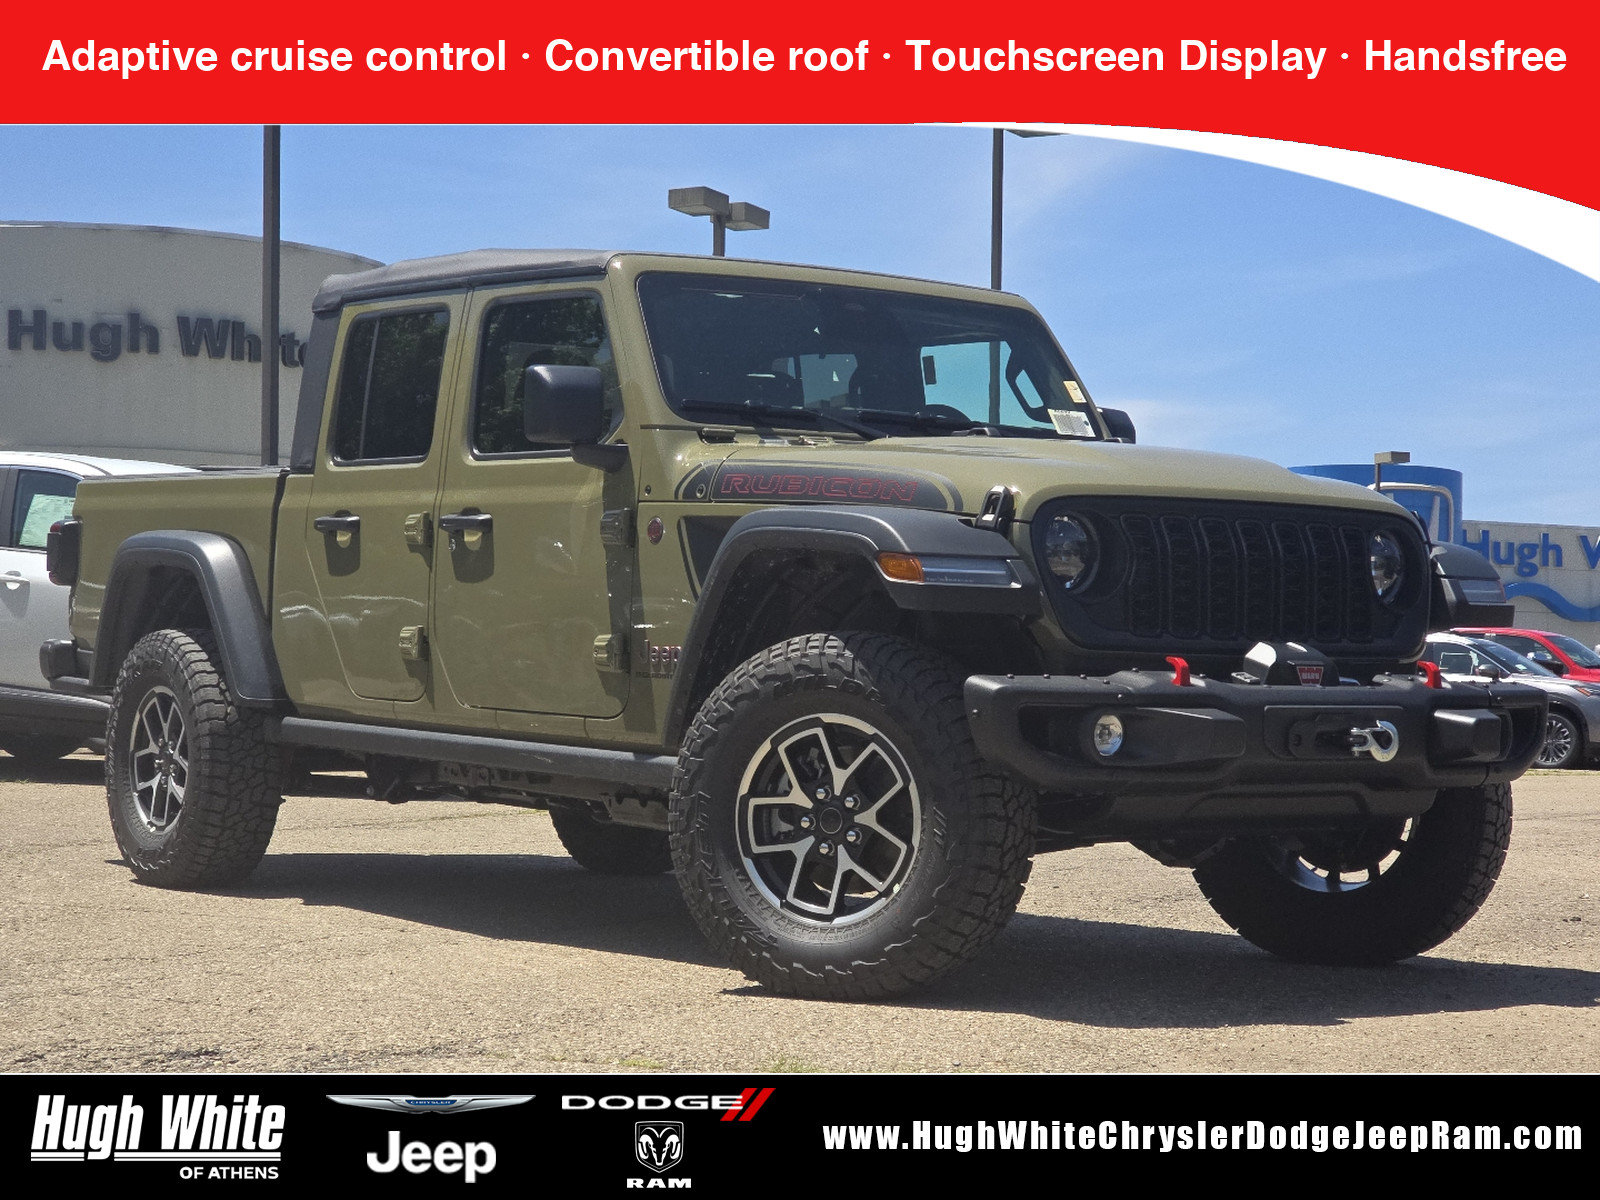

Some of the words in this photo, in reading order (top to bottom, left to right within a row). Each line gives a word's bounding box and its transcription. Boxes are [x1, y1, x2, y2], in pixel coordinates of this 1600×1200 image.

[7, 309, 160, 362] Hugh
[177, 315, 310, 368] Wht
[721, 473, 918, 502] RUBICON
